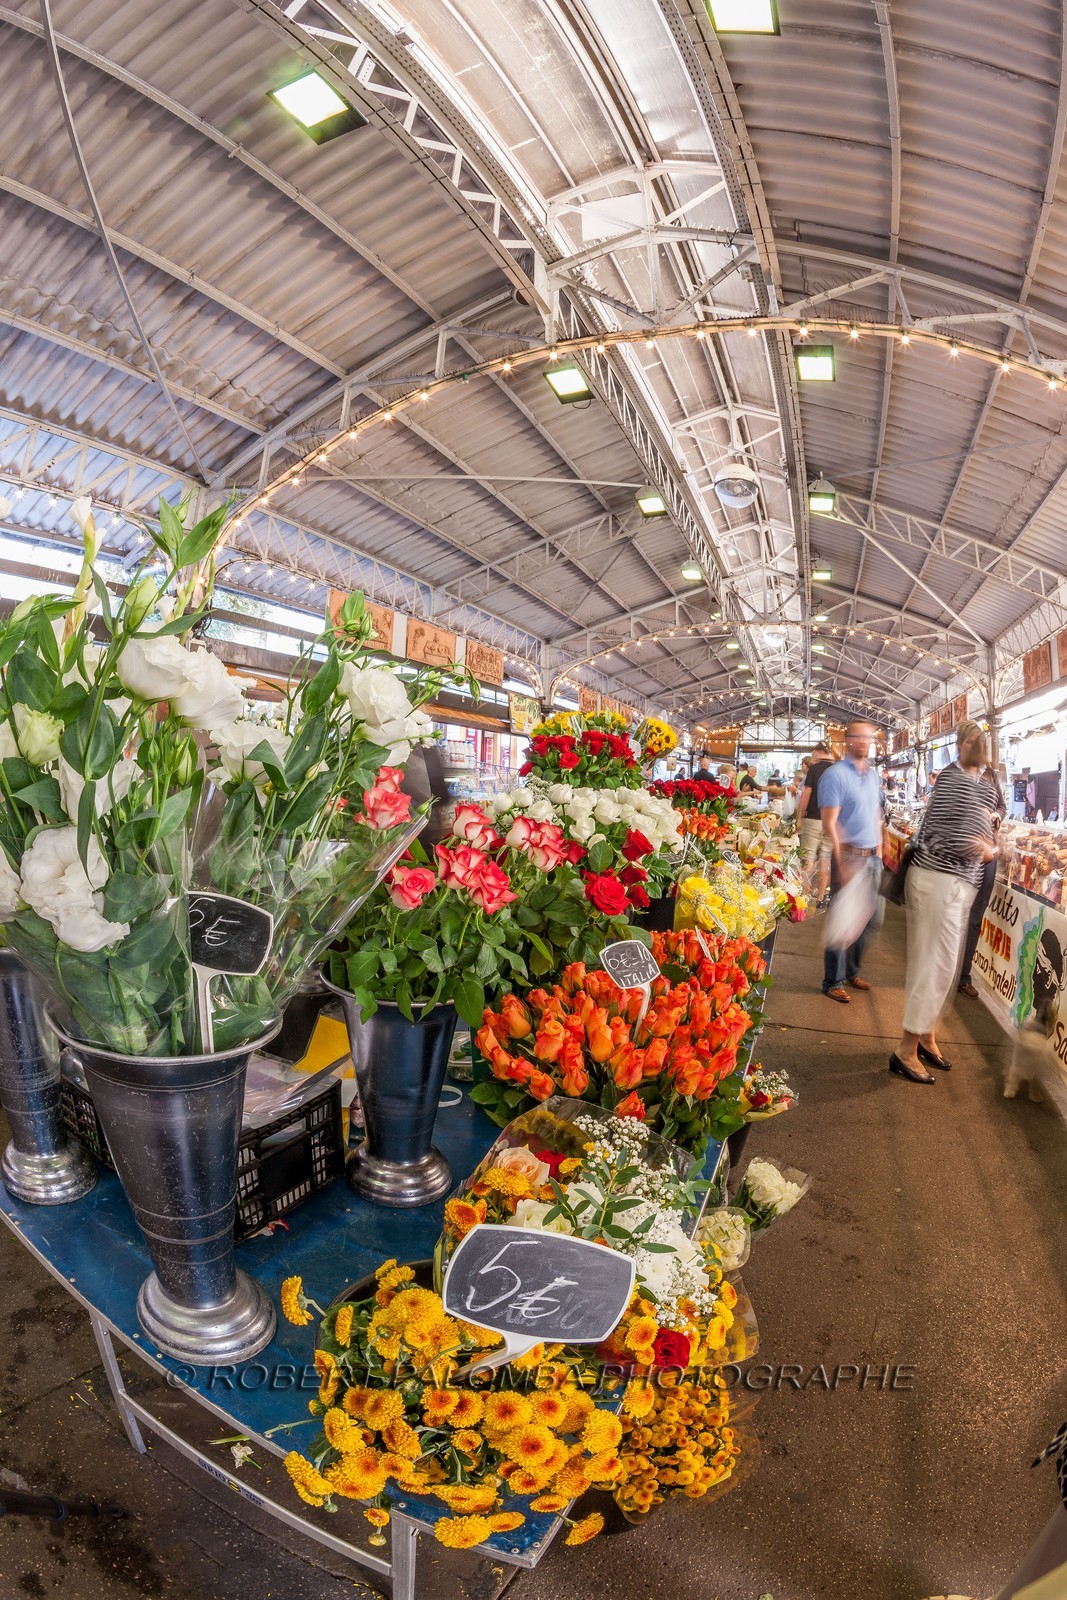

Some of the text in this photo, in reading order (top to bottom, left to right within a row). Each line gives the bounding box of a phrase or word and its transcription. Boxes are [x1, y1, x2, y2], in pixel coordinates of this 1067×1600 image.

[989, 889, 1019, 927] uits
[980, 917, 1011, 962] UTERIE
[465, 1240, 580, 1319] 5€
